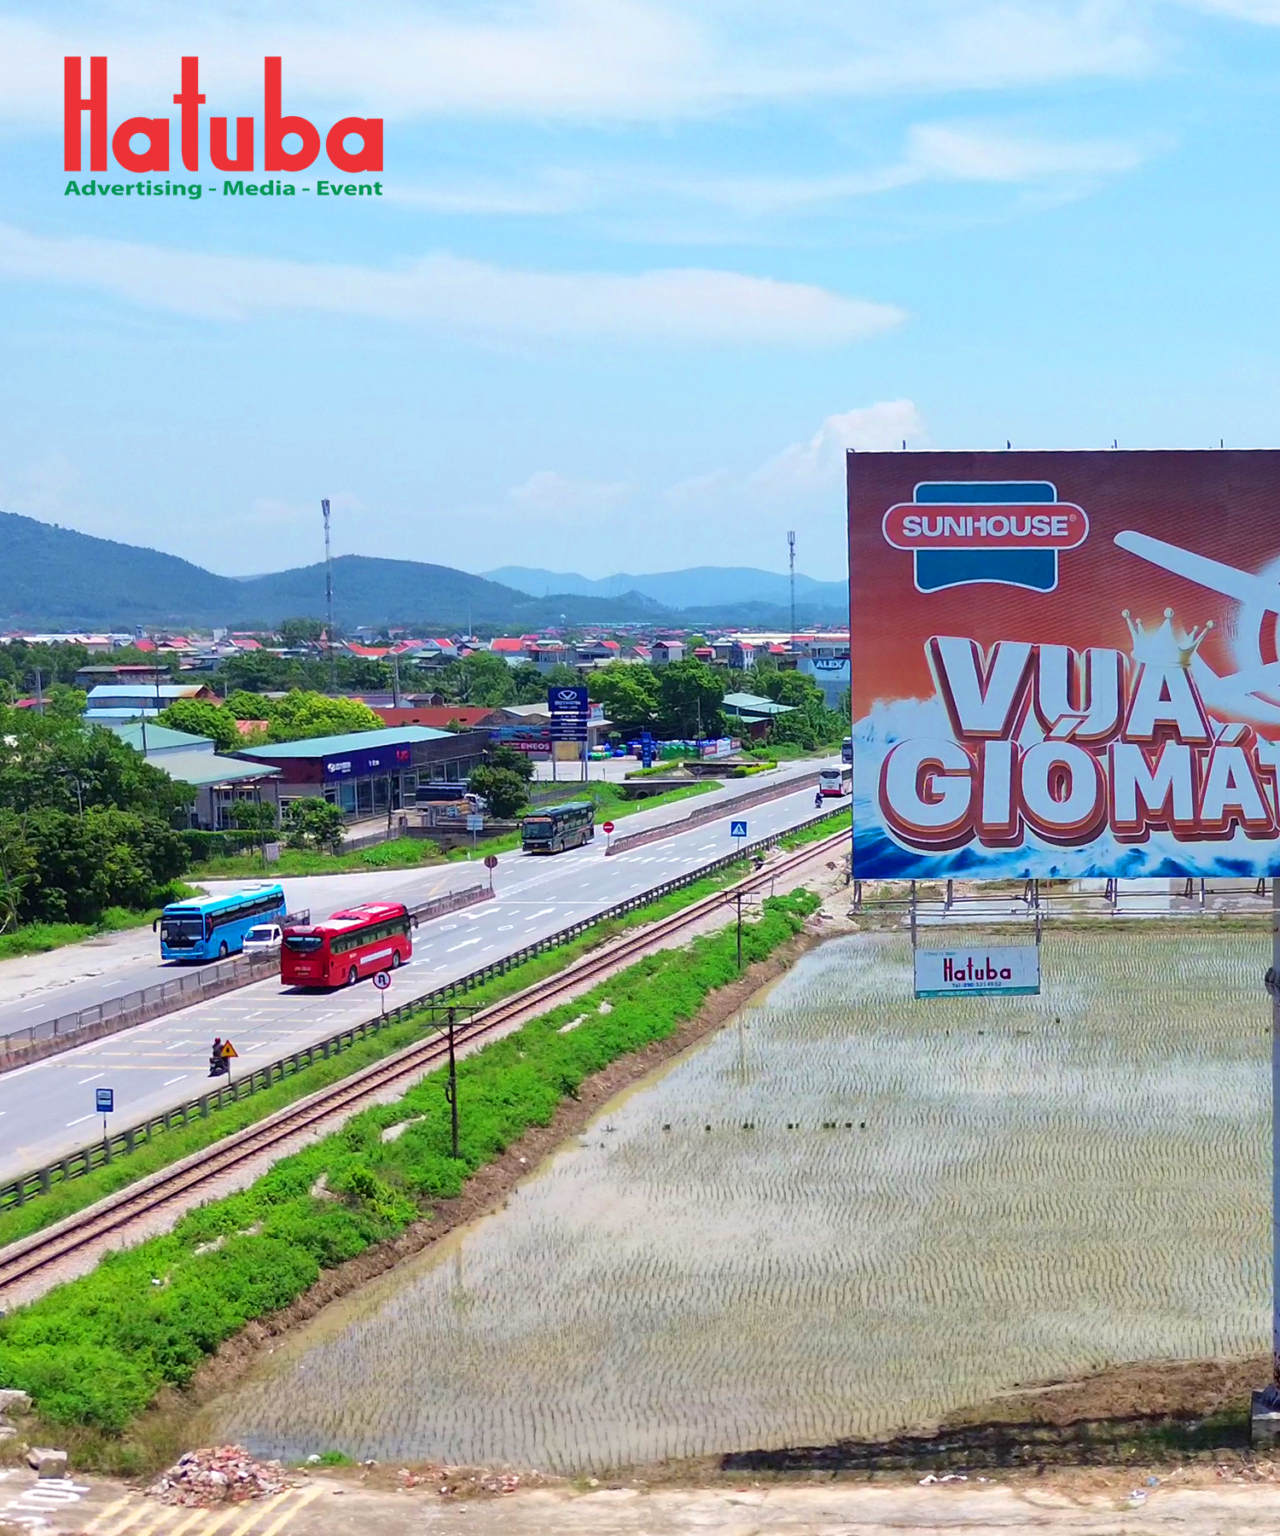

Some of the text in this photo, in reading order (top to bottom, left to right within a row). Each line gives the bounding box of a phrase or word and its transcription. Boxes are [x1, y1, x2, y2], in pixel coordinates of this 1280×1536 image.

[520, 742, 550, 750] ENEOS
[879, 714, 1109, 849] GIÓ
[943, 957, 1012, 982] Hatuba
